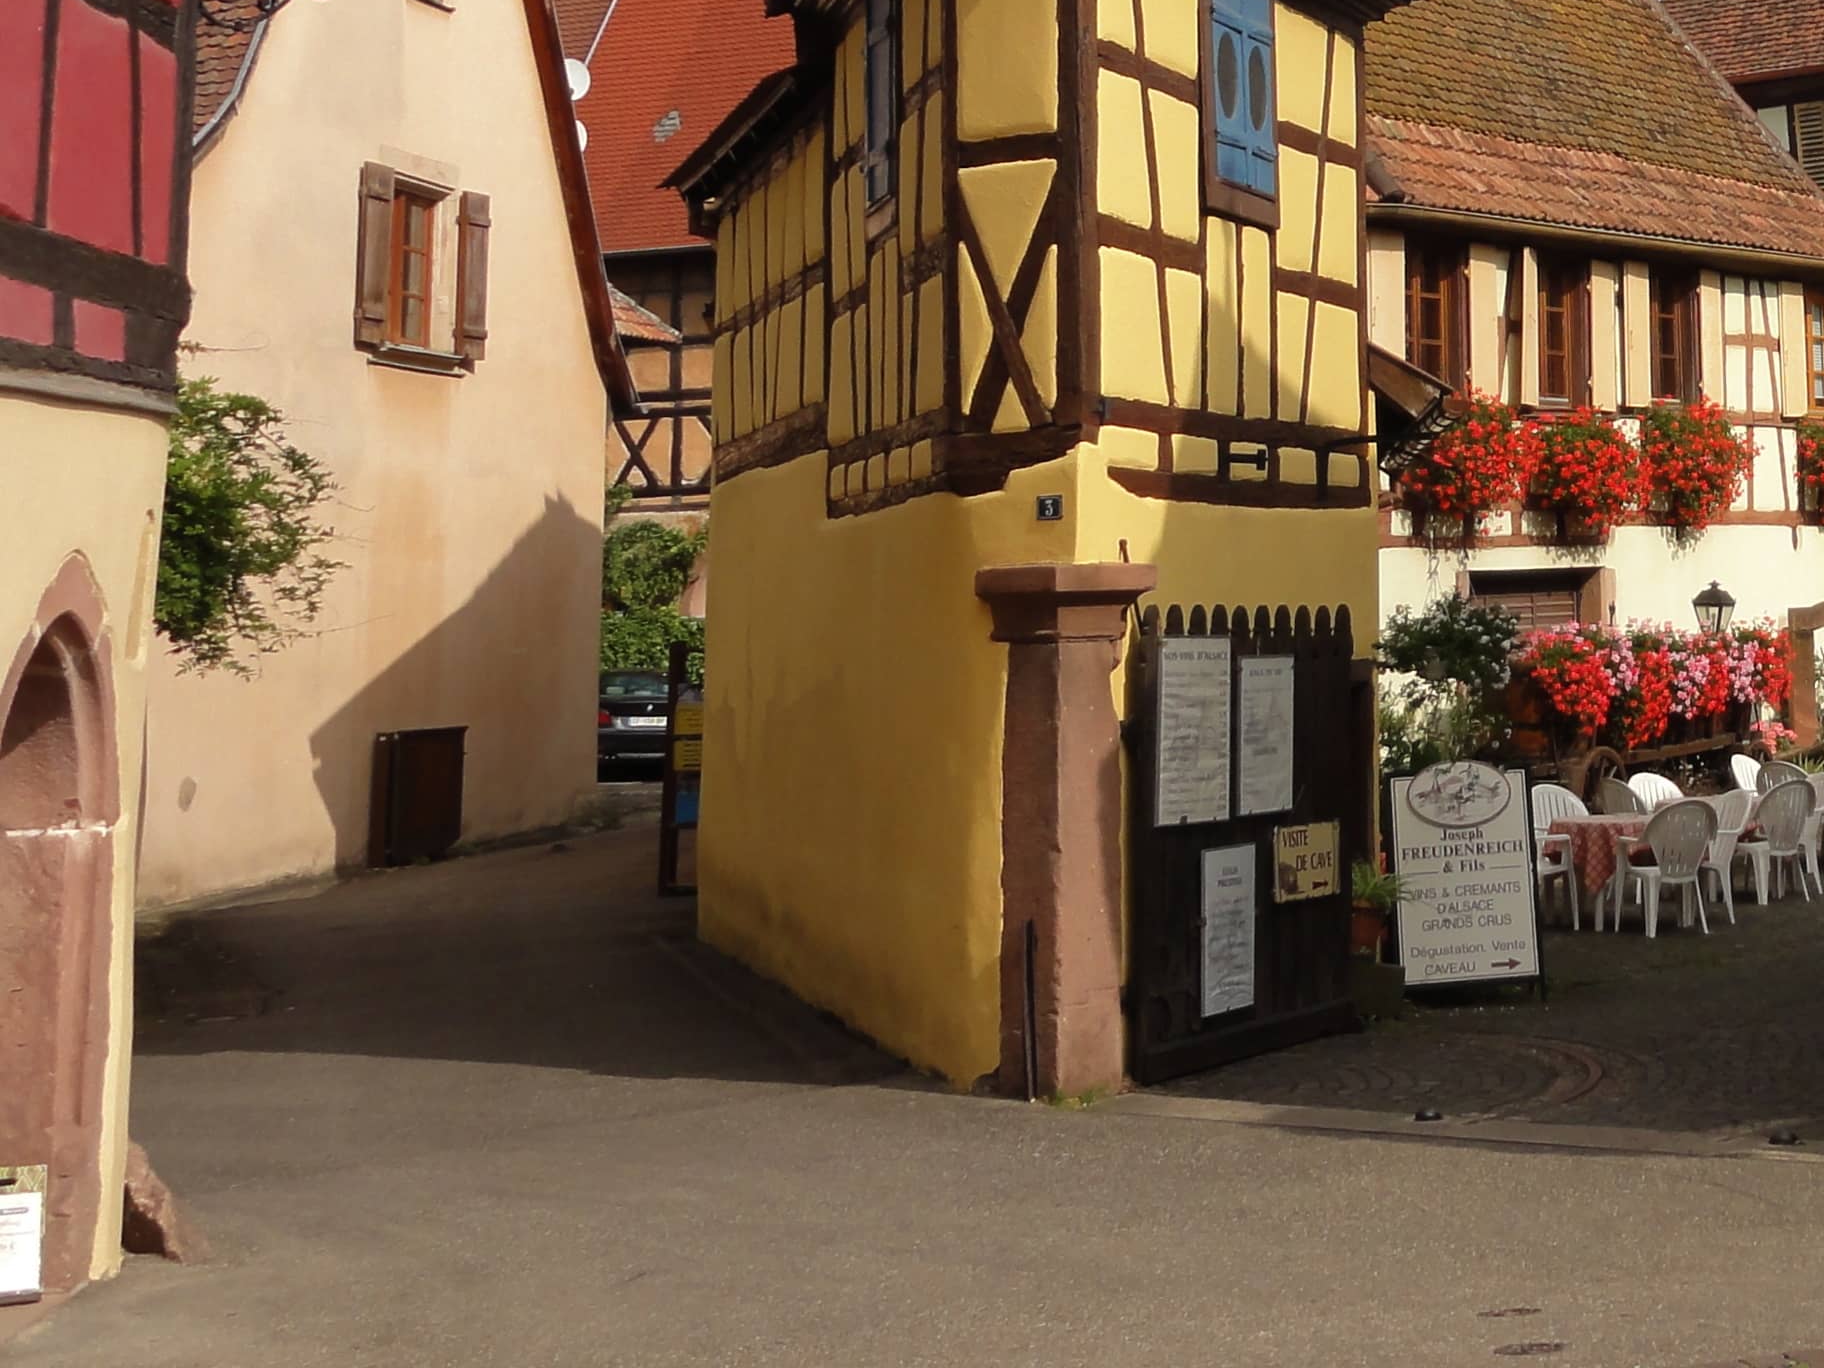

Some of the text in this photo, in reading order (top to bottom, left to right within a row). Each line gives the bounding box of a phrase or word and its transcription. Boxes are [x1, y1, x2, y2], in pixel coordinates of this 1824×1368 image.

[1044, 499, 1054, 516] 3
[1282, 830, 1308, 848] VISITE
[1440, 827, 1484, 842] Joseph
[1401, 840, 1524, 861] FREUDENREICH
[1296, 851, 1333, 872] DE CAVE
[1443, 860, 1486, 873] & Fils
[1409, 881, 1521, 900] VINS & CREMANTS
[1422, 913, 1512, 932] GRANDS CRUS
[1492, 939, 1526, 951] Vente
[1424, 962, 1477, 976] CAVEAU
